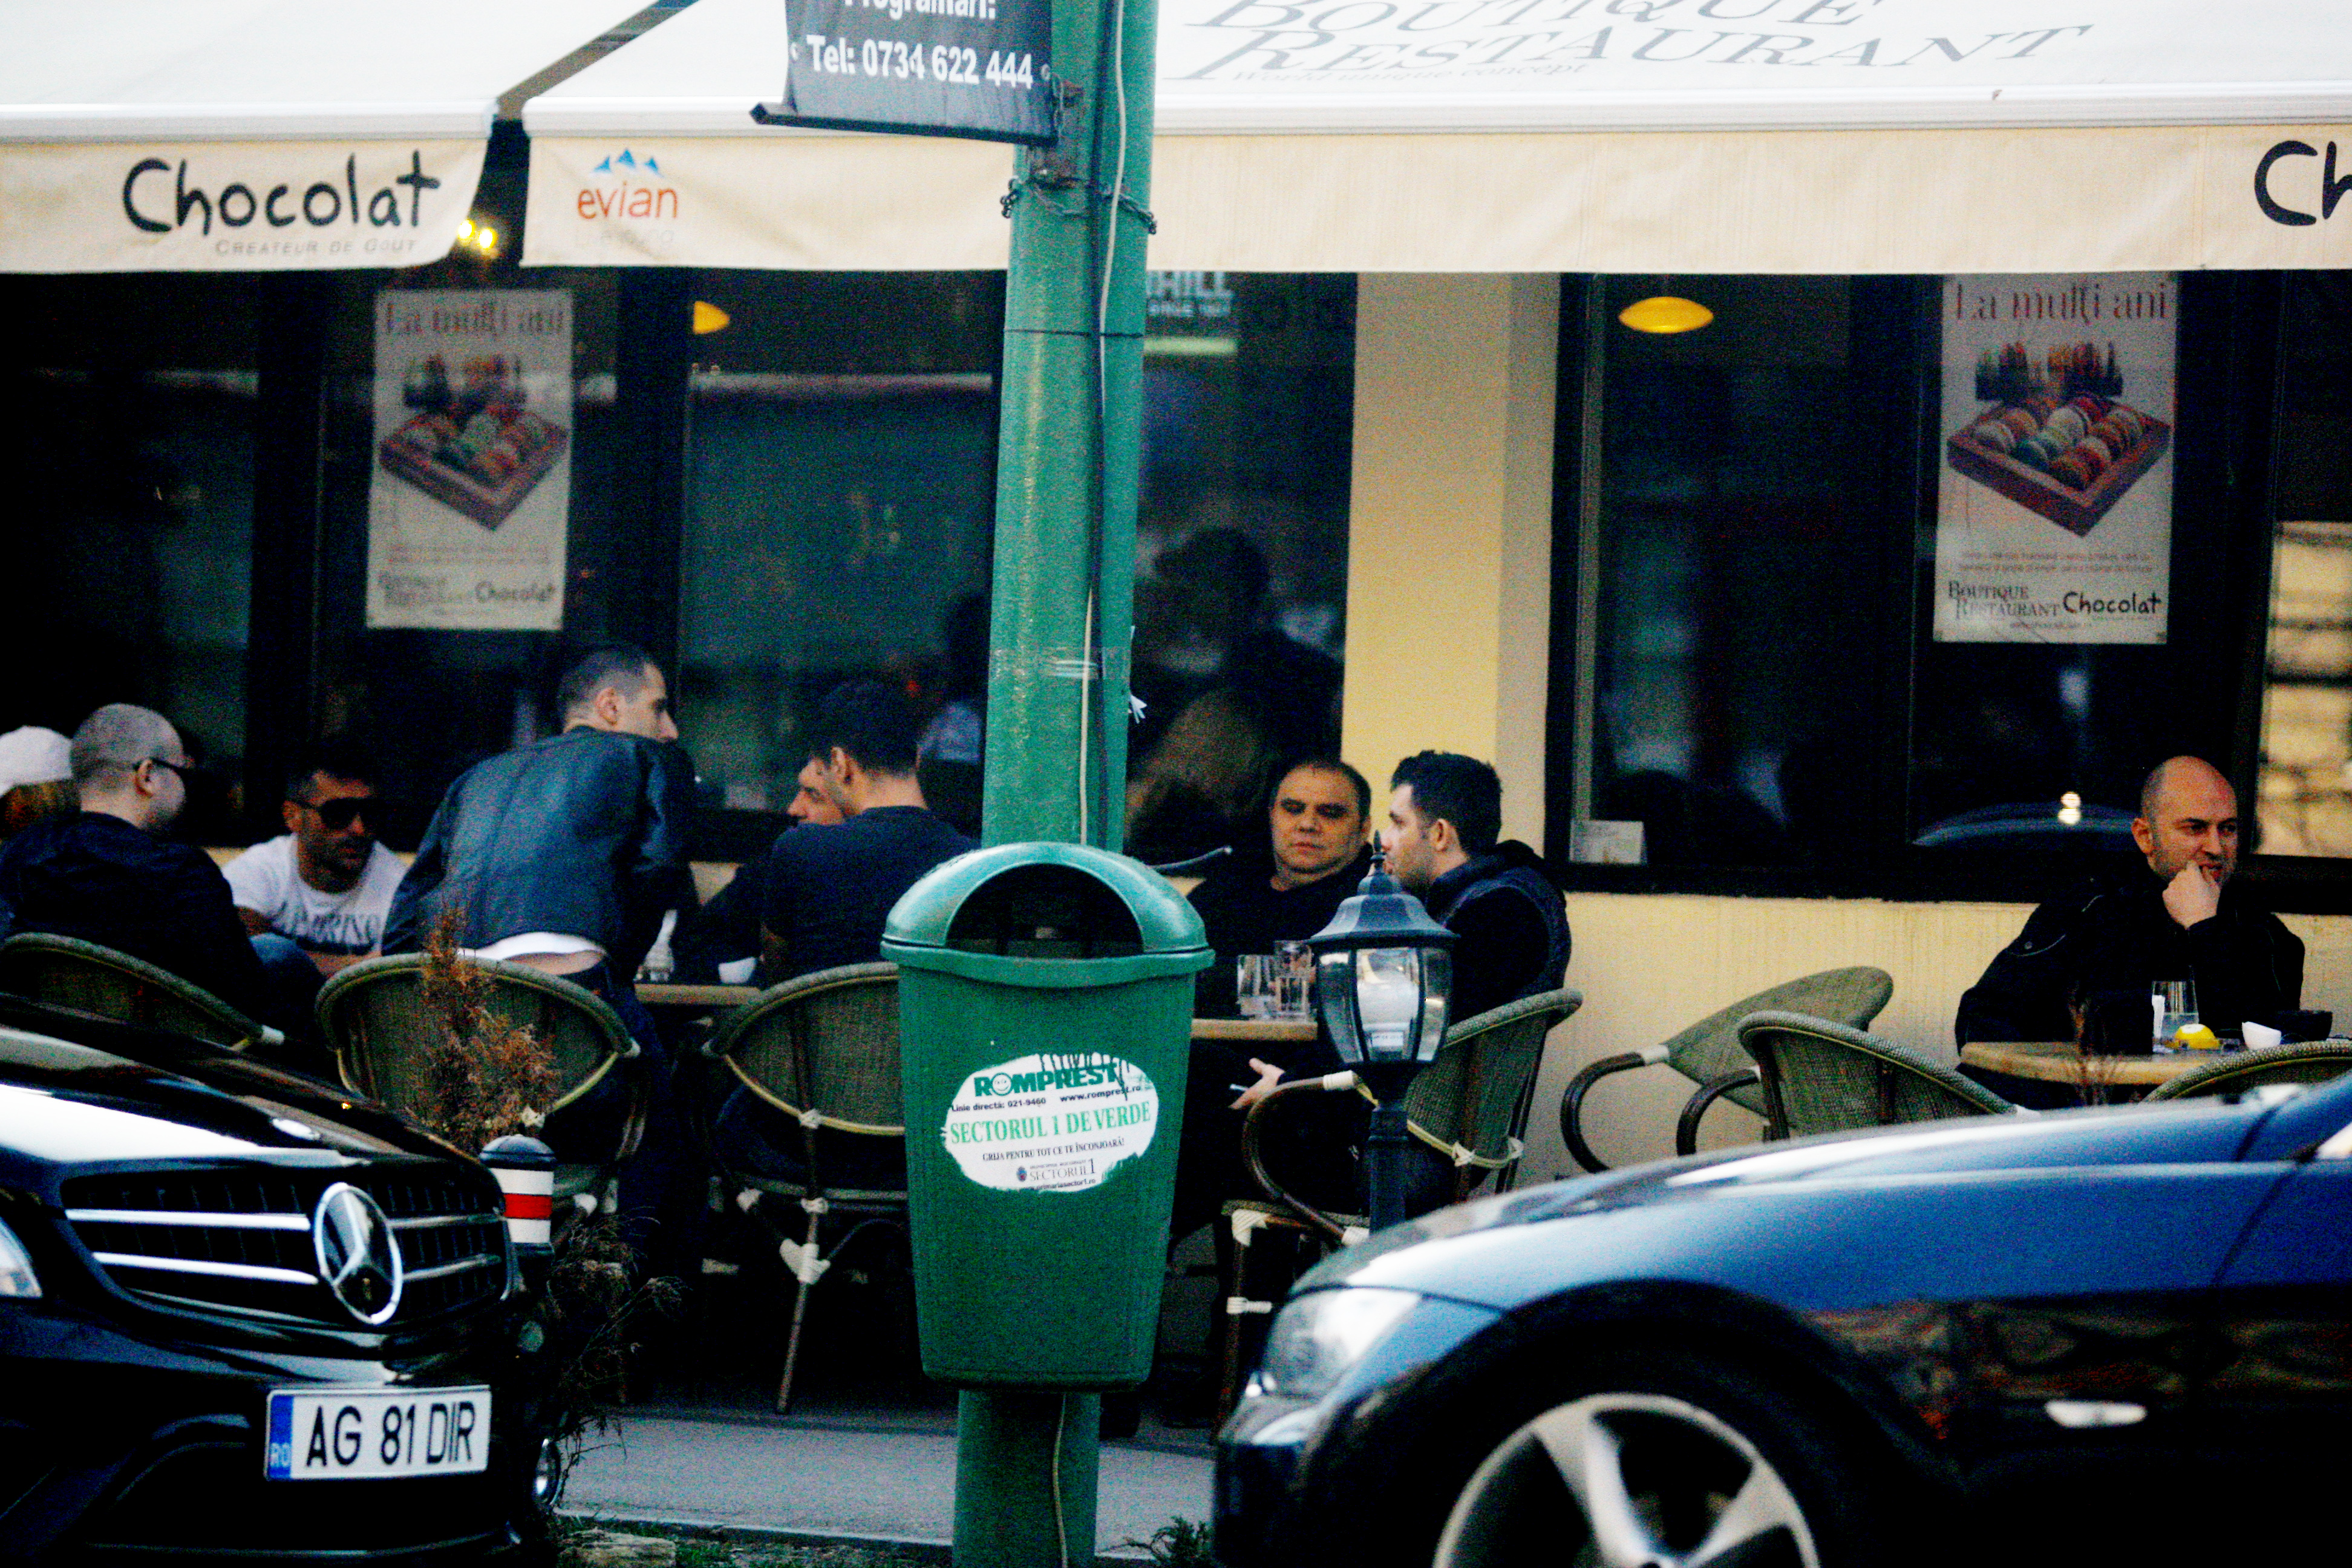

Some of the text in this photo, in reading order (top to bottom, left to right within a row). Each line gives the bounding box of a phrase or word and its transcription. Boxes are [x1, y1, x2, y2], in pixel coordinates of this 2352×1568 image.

[806, 34, 1033, 89] Tel: 0734 622 444
[1163, 24, 2094, 80] RESTAURANT
[1337, 69, 1454, 82] unique
[1462, 62, 1590, 77] concept
[123, 149, 440, 235] Chocolat
[577, 180, 678, 220] evian
[215, 239, 319, 256] CREATEUR
[329, 240, 353, 255] DE
[1956, 283, 1997, 320] La
[2113, 283, 2167, 319] ani
[2063, 591, 2162, 615] Chocolat
[973, 1063, 1118, 1097] ROMPREST
[950, 1101, 1151, 1144] SECTORUL 1 DE VERDE
[1005, 1149, 1034, 1160] PENTRU
[1037, 1148, 1051, 1157] TOT
[1053, 1146, 1063, 1155] CE
[1088, 1158, 1096, 1174] 1
[306, 1400, 475, 1468] AG 81 DIR
